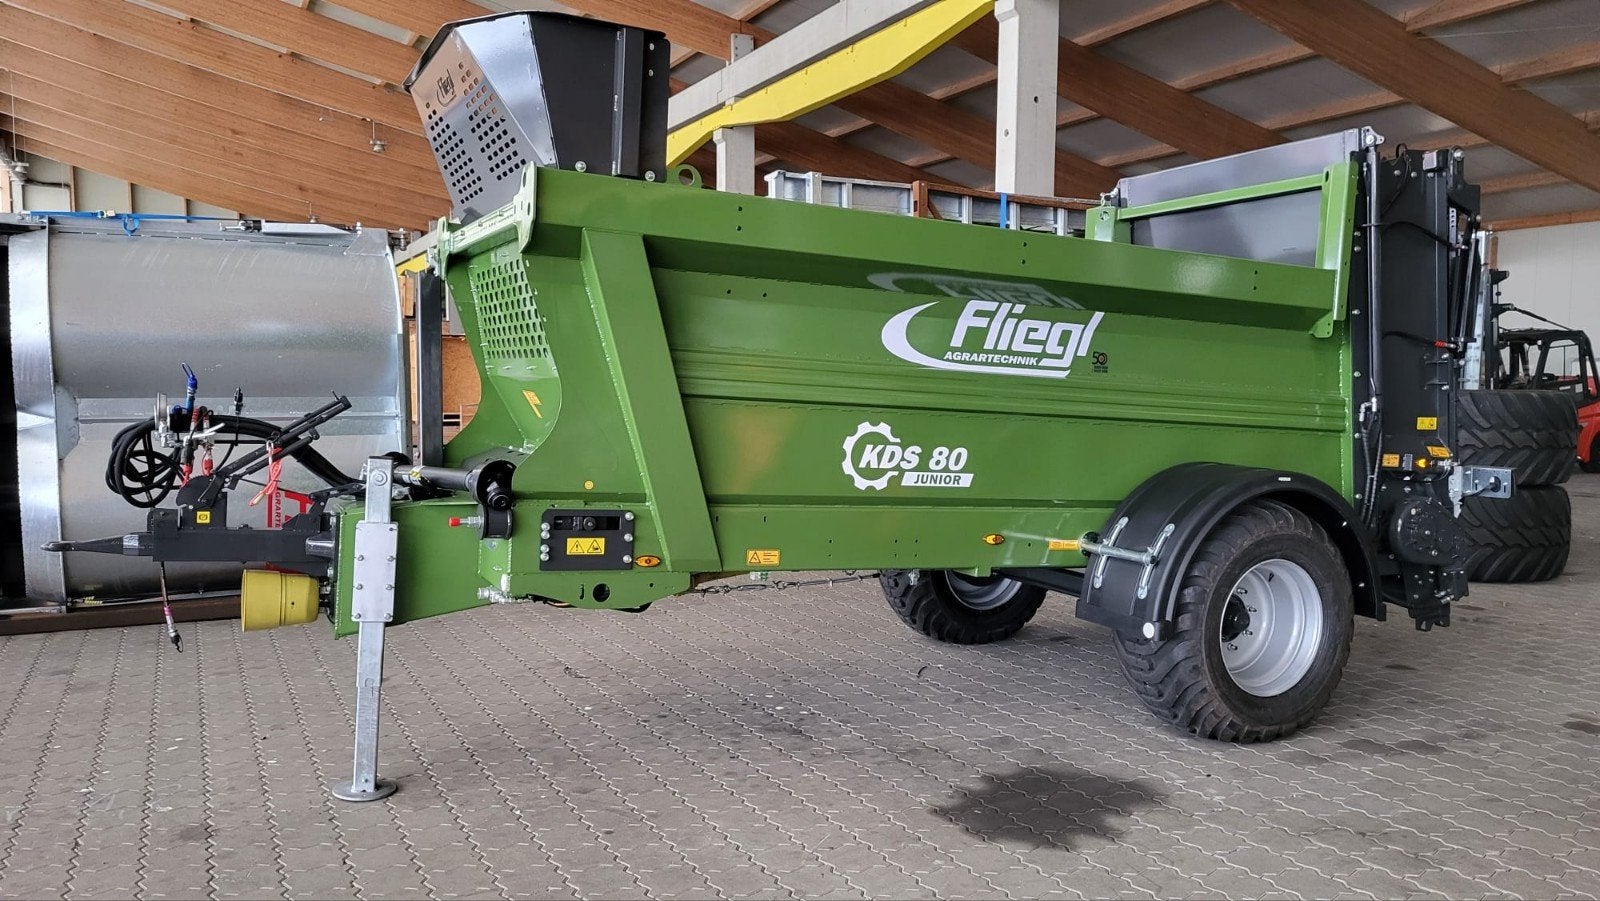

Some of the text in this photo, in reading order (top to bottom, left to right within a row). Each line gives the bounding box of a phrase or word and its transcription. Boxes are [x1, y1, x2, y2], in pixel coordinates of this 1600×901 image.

[950, 300, 1105, 367] Fliegl
[944, 351, 1040, 366] AGRARTECHNIK
[859, 444, 968, 471] KDS 80
[914, 474, 962, 486] JUNIOR
